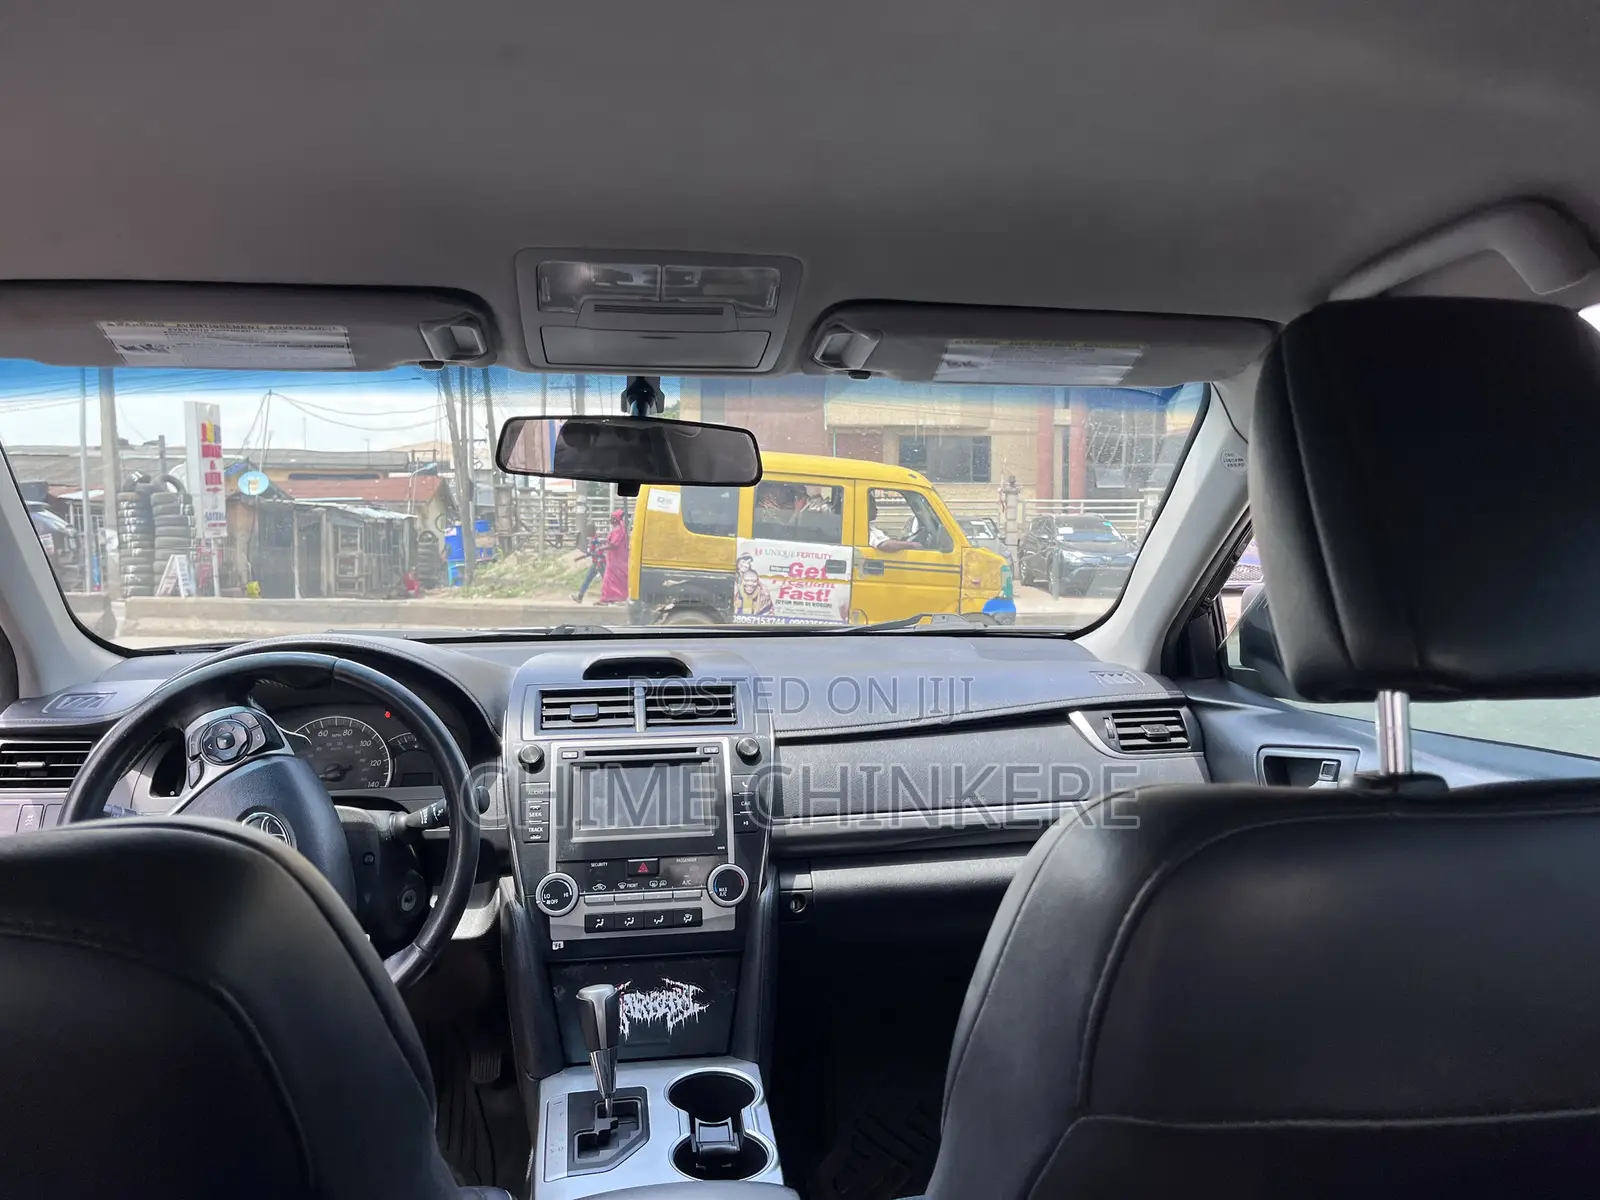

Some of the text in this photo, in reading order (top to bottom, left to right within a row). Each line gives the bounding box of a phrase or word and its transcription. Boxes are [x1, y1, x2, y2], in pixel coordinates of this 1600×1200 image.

[765, 548, 795, 558] UNIQUE
[796, 551, 833, 560] FERTILITY
[788, 562, 828, 581] Get
[778, 586, 831, 602] Fast!
[318, 729, 329, 737] 60
[342, 728, 353, 737] 80
[370, 759, 382, 767] 120
